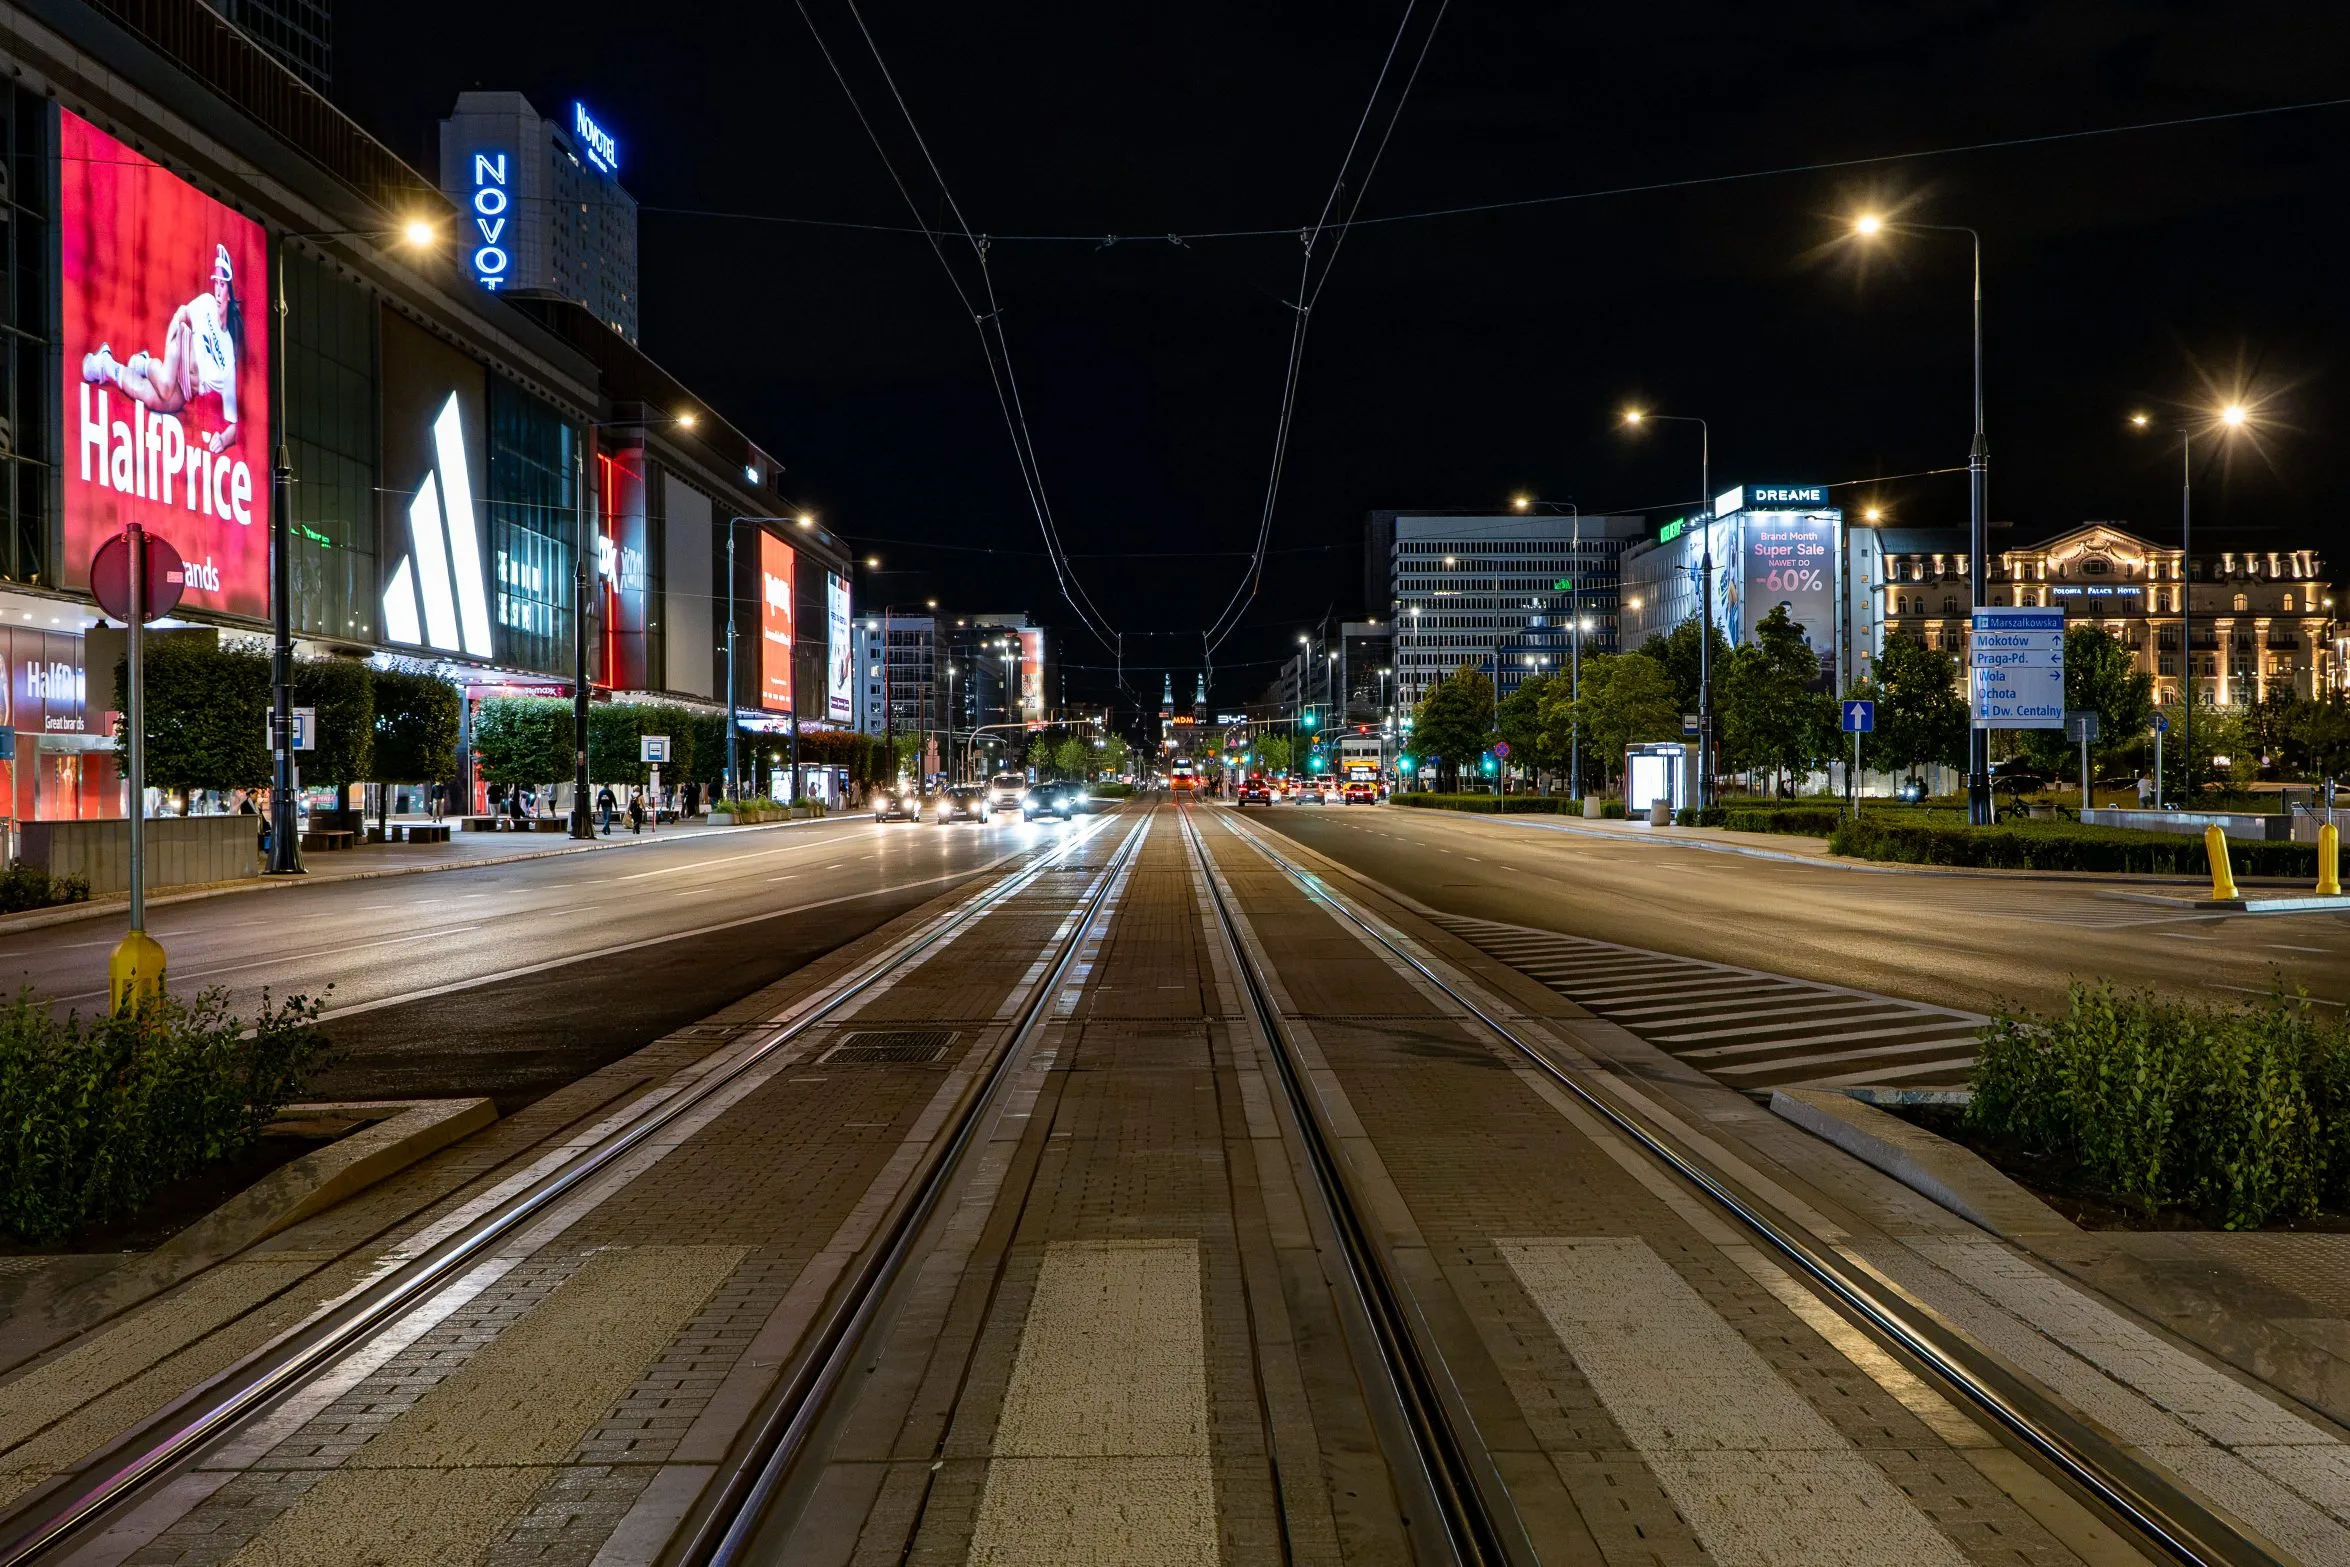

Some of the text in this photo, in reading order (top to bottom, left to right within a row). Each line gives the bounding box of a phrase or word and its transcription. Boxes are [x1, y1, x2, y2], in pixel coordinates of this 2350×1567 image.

[576, 102, 617, 169] NOVOTEL
[80, 382, 252, 526] HalfPrice
[1756, 489, 1820, 501] DREAME
[1760, 532, 1818, 541] Brand Month
[1754, 543, 1825, 559] Super Sale
[1768, 559, 1810, 567] NAWET DO
[182, 556, 220, 592] ands
[1755, 569, 1823, 592] -60%
[1977, 634, 2029, 646] Mokotów
[1977, 652, 2029, 667] Praga-Pd.
[1979, 670, 2006, 681] Wola
[1979, 687, 2016, 699] Ochota
[1992, 703, 2062, 719] Dw. Centalny
[45, 714, 63, 730] Great
[1172, 716, 1194, 724] MDM
